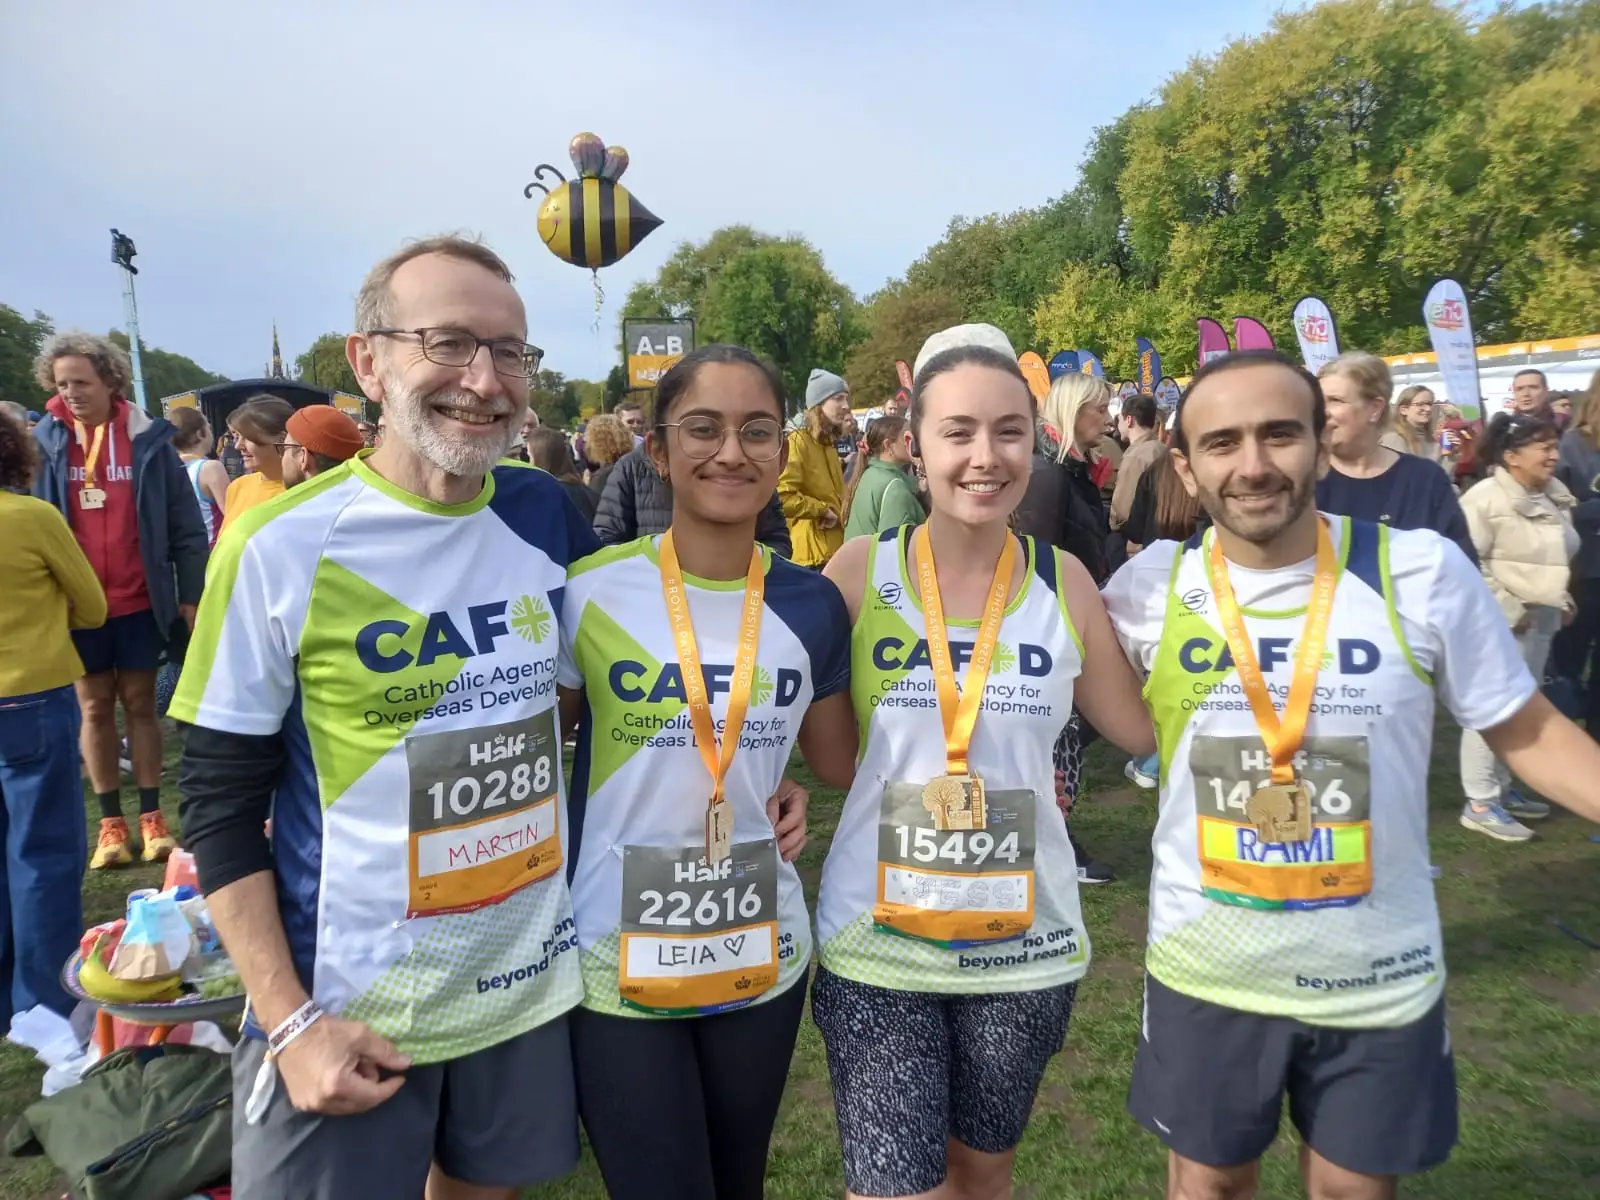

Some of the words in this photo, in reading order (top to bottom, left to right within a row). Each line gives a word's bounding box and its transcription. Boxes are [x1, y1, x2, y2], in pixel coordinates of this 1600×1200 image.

[636, 335, 683, 356] A-B
[744, 591, 760, 649] FINISHER
[984, 583, 1004, 638] FINISHER
[668, 578, 704, 710] #ROYALPARKSHALF
[740, 656, 752, 688] 2024
[384, 671, 485, 704] Catholic
[870, 695, 937, 708] Overseas
[881, 679, 936, 692] Catholi
[1020, 684, 1040, 698] for
[1341, 684, 1367, 698] for
[364, 697, 473, 726] Overseas
[1181, 699, 1252, 711] Overseas
[611, 728, 686, 748] Overseas
[770, 717, 786, 731] for
[469, 733, 526, 766] Half
[428, 755, 551, 819] 10288
[448, 822, 539, 867] MARTIN
[895, 825, 1020, 865] 15494
[1237, 827, 1334, 862] RAMI
[674, 858, 732, 883] Half
[639, 883, 762, 926] 22616
[555, 917, 575, 936] on
[1022, 937, 1044, 949] no
[1047, 927, 1074, 942] one
[658, 944, 716, 966] LEIA
[958, 951, 1028, 970] beyond
[1033, 940, 1077, 961] reach
[476, 955, 549, 994] beyond
[1296, 972, 1377, 991] beyond
